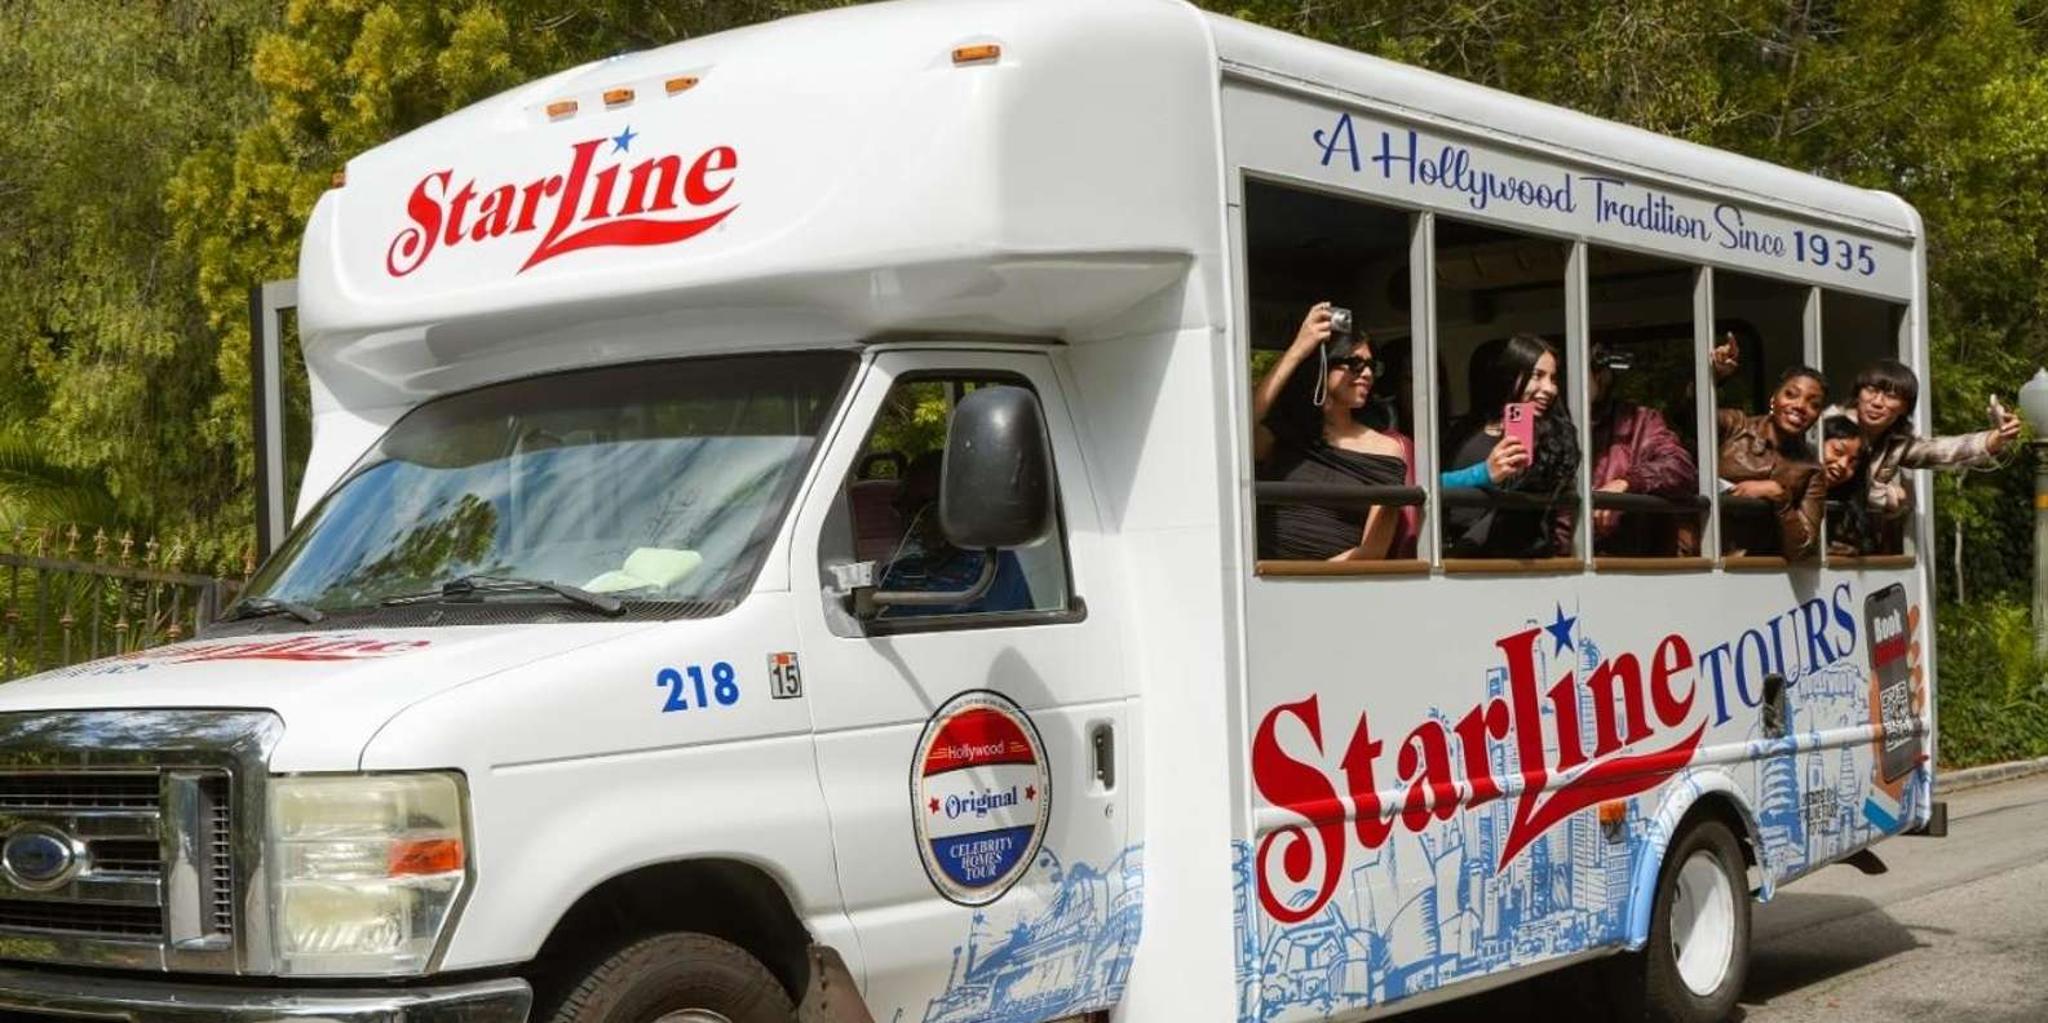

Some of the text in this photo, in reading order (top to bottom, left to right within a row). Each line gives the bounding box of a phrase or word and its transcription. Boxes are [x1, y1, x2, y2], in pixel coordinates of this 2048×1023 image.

[1313, 113, 1876, 277] A Hollywood Tradition Since 1935
[1699, 582, 1857, 727] TOURS
[656, 661, 740, 713] 218
[773, 665, 799, 695] 15
[948, 741, 1005, 762] Hollywood
[945, 785, 1018, 820] Original
[950, 836, 1014, 859] CELEBRITY
[961, 850, 1003, 870] HOMES
[965, 863, 997, 881] TOUR
